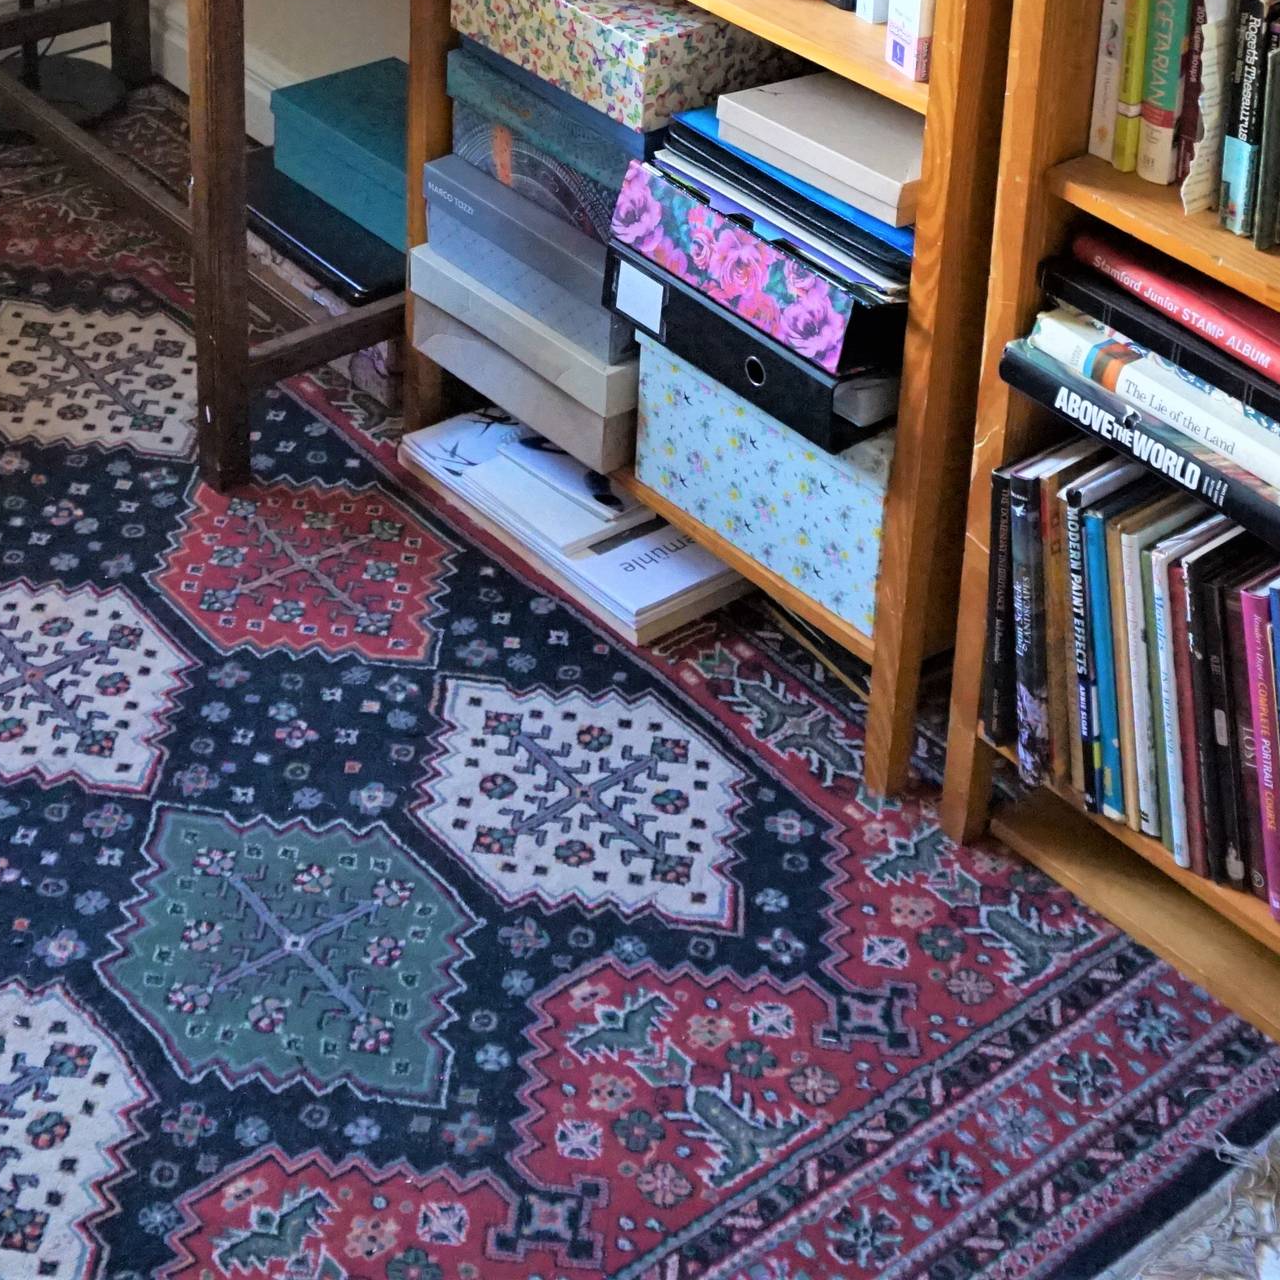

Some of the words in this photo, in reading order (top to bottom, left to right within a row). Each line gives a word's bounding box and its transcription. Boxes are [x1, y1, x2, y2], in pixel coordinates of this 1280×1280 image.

[1245, 15, 1262, 65] Roget's
[1189, 53, 1199, 82] soups
[1238, 65, 1257, 141] Thesaurus
[428, 181, 454, 203] MARCO
[454, 197, 474, 216] TOZZI
[1092, 254, 1143, 293] Stamford
[1143, 285, 1180, 315] Junior
[1180, 307, 1225, 340] STAMP
[1225, 334, 1272, 369] ALBUM
[1053, 385, 1115, 441] ABOVE
[1112, 420, 1134, 449] THE
[1132, 430, 1201, 491] WORLD
[1124, 379, 1147, 403] The
[1147, 391, 1168, 414] Lie
[1168, 403, 1184, 423] of
[1183, 415, 1203, 437] the
[1203, 423, 1236, 456] Land
[1067, 507, 1081, 570] MODERN
[1022, 576, 1032, 642] LANDSCAPES
[1070, 571, 1084, 616] PAINT
[1073, 617, 1087, 674] EFFECTS
[1254, 614, 1265, 651] Reader's
[1254, 652, 1267, 681] Digest
[1079, 684, 1087, 709] ANNIE
[1257, 682, 1271, 736] COMPLETE
[1080, 710, 1088, 737] SLOAN
[1261, 738, 1273, 789] PORTRAIT
[1265, 790, 1276, 832] COURSE
